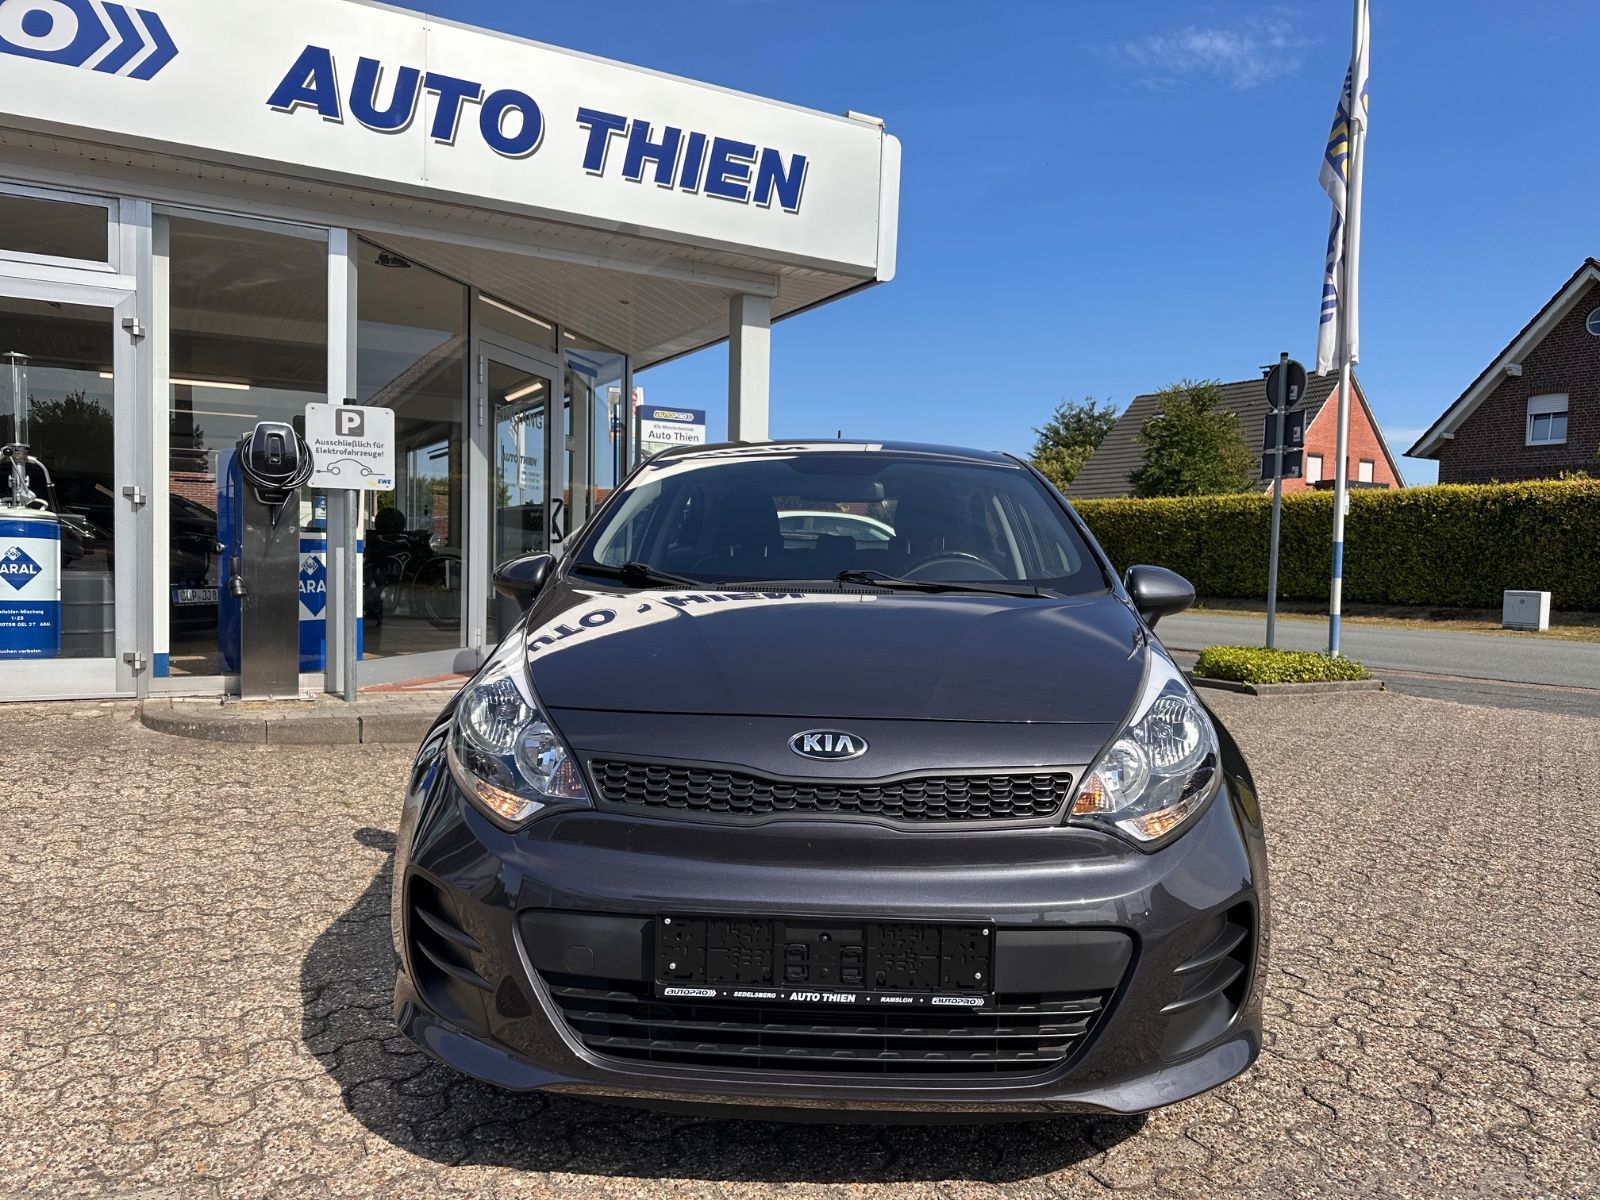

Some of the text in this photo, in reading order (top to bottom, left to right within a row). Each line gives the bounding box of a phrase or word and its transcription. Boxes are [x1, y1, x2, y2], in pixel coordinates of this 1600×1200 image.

[266, 44, 809, 215] AUTO THIEN
[342, 411, 361, 434] P
[648, 430, 699, 442] Auto Thien
[315, 439, 384, 449] Ausschließlich für
[315, 447, 384, 458] Elektrofahrzeuge!
[0, 563, 37, 574] ARAL
[803, 734, 855, 753] KIA
[734, 991, 776, 999] SEDELSBERG
[790, 992, 821, 1001] AUTO
[822, 993, 856, 1003] THIEN
